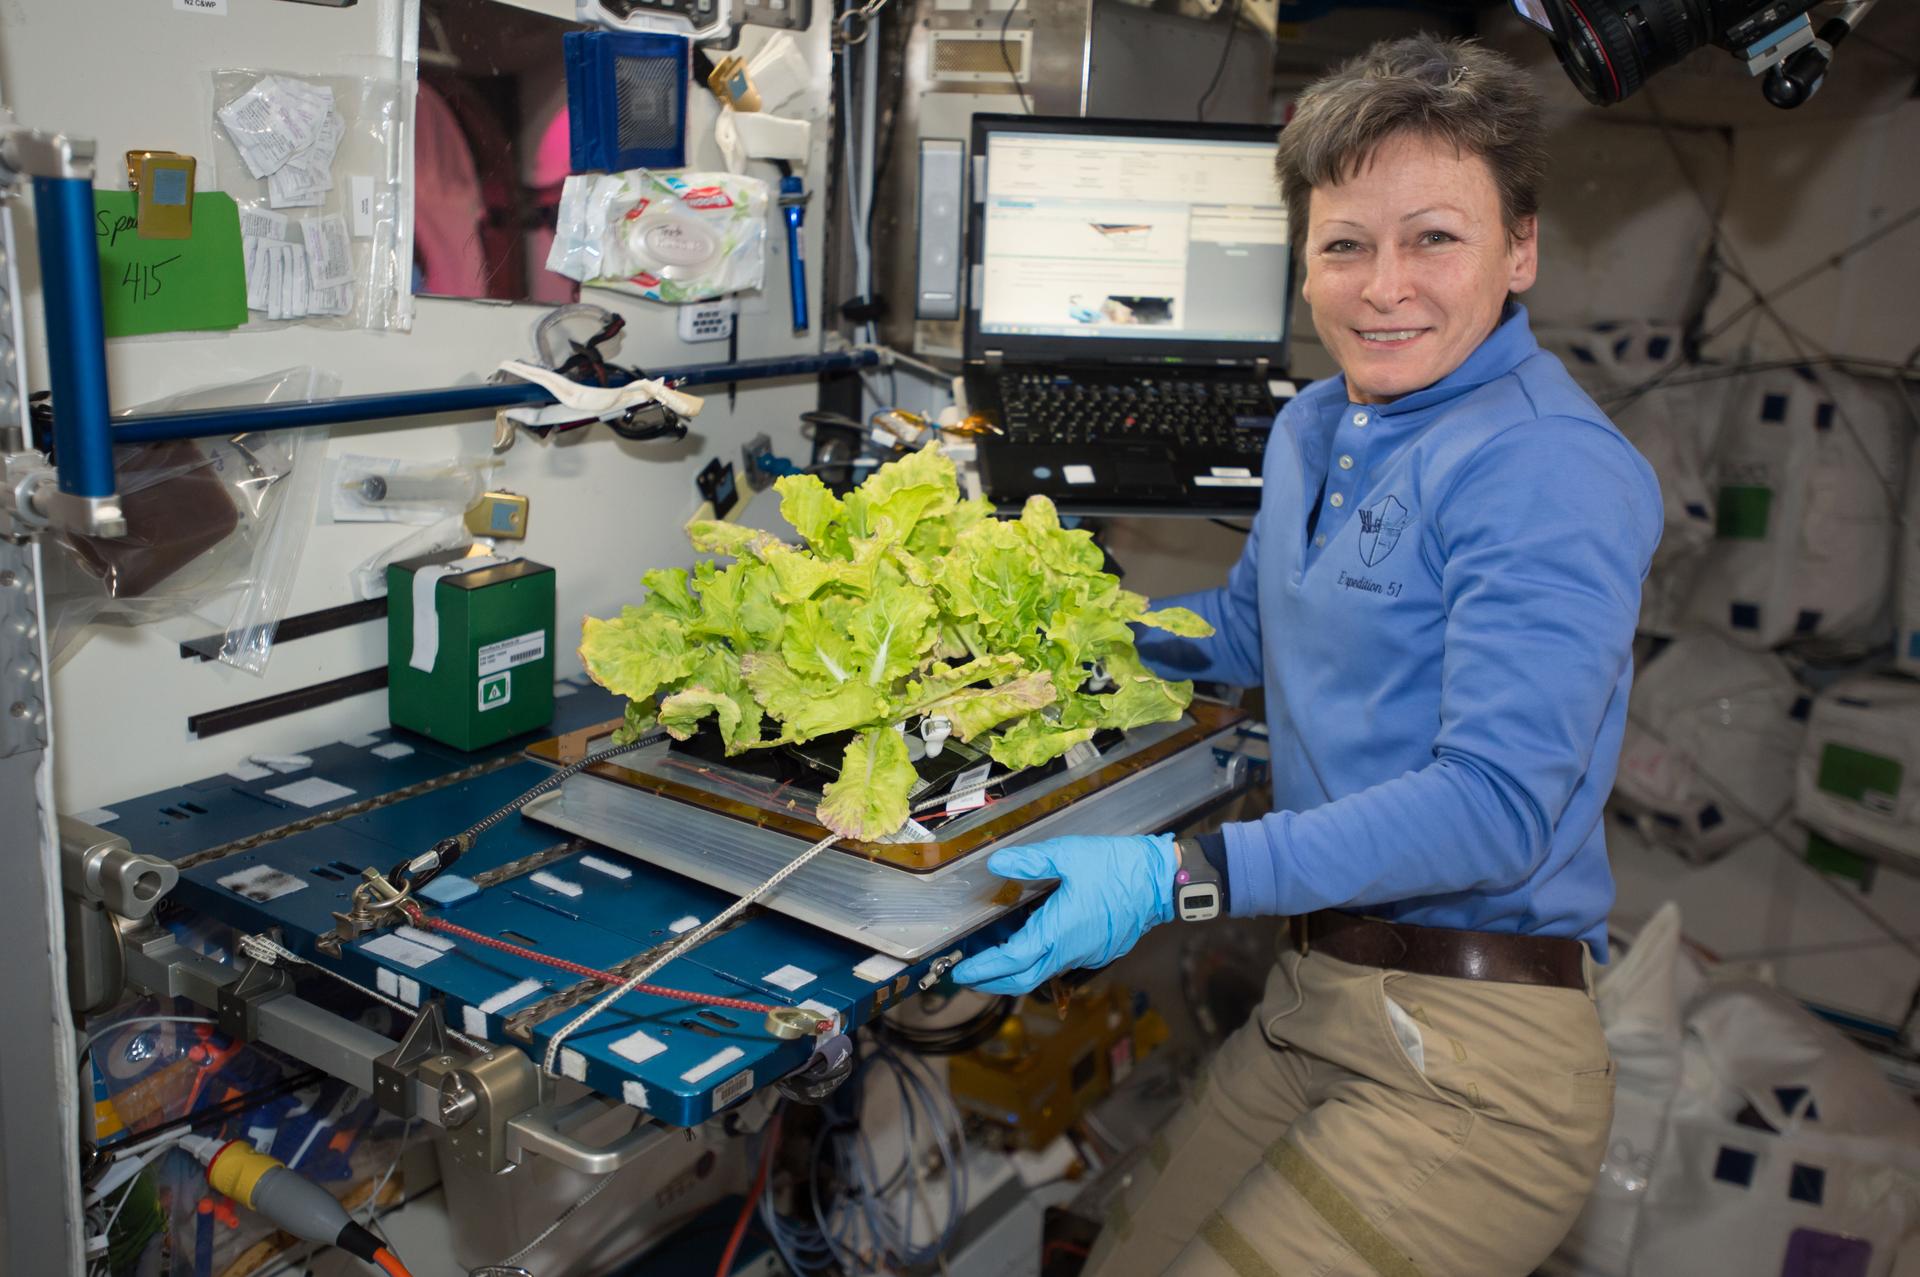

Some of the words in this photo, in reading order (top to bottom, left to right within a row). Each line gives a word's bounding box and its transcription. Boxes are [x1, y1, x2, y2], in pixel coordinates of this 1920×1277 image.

[122, 254, 182, 304] 415
[1337, 570, 1382, 593] Expedition
[1386, 581, 1403, 598] 51
